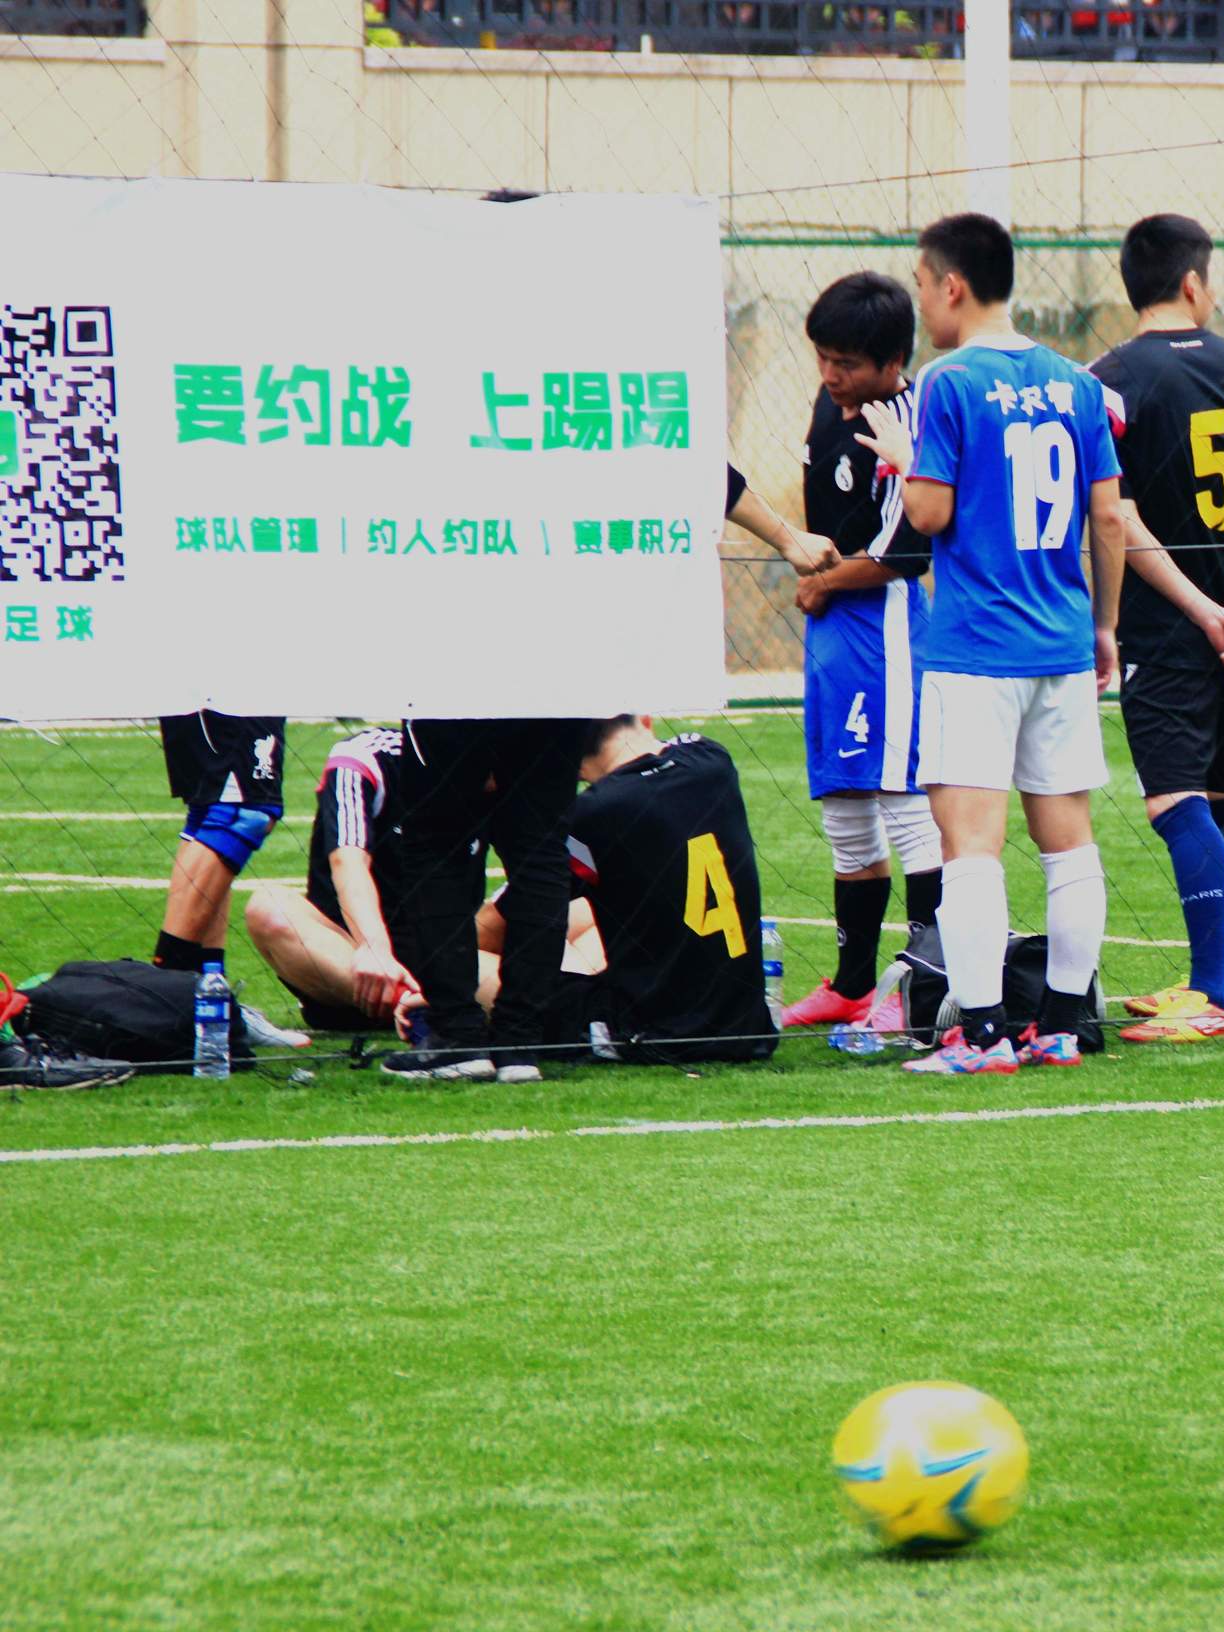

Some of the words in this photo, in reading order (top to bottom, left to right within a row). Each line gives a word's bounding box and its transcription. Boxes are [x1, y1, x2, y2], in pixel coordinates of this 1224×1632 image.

[174, 364, 411, 447] 要约战
[470, 371, 688, 451] 上踢踢
[1004, 421, 1076, 550] 19
[175, 517, 318, 553] 球队管理
[367, 518, 517, 554] 约人约队
[572, 519, 690, 554] 赛事积分
[5, 605, 94, 641] 足球
[845, 692, 869, 743] 4
[683, 832, 748, 958] 4
